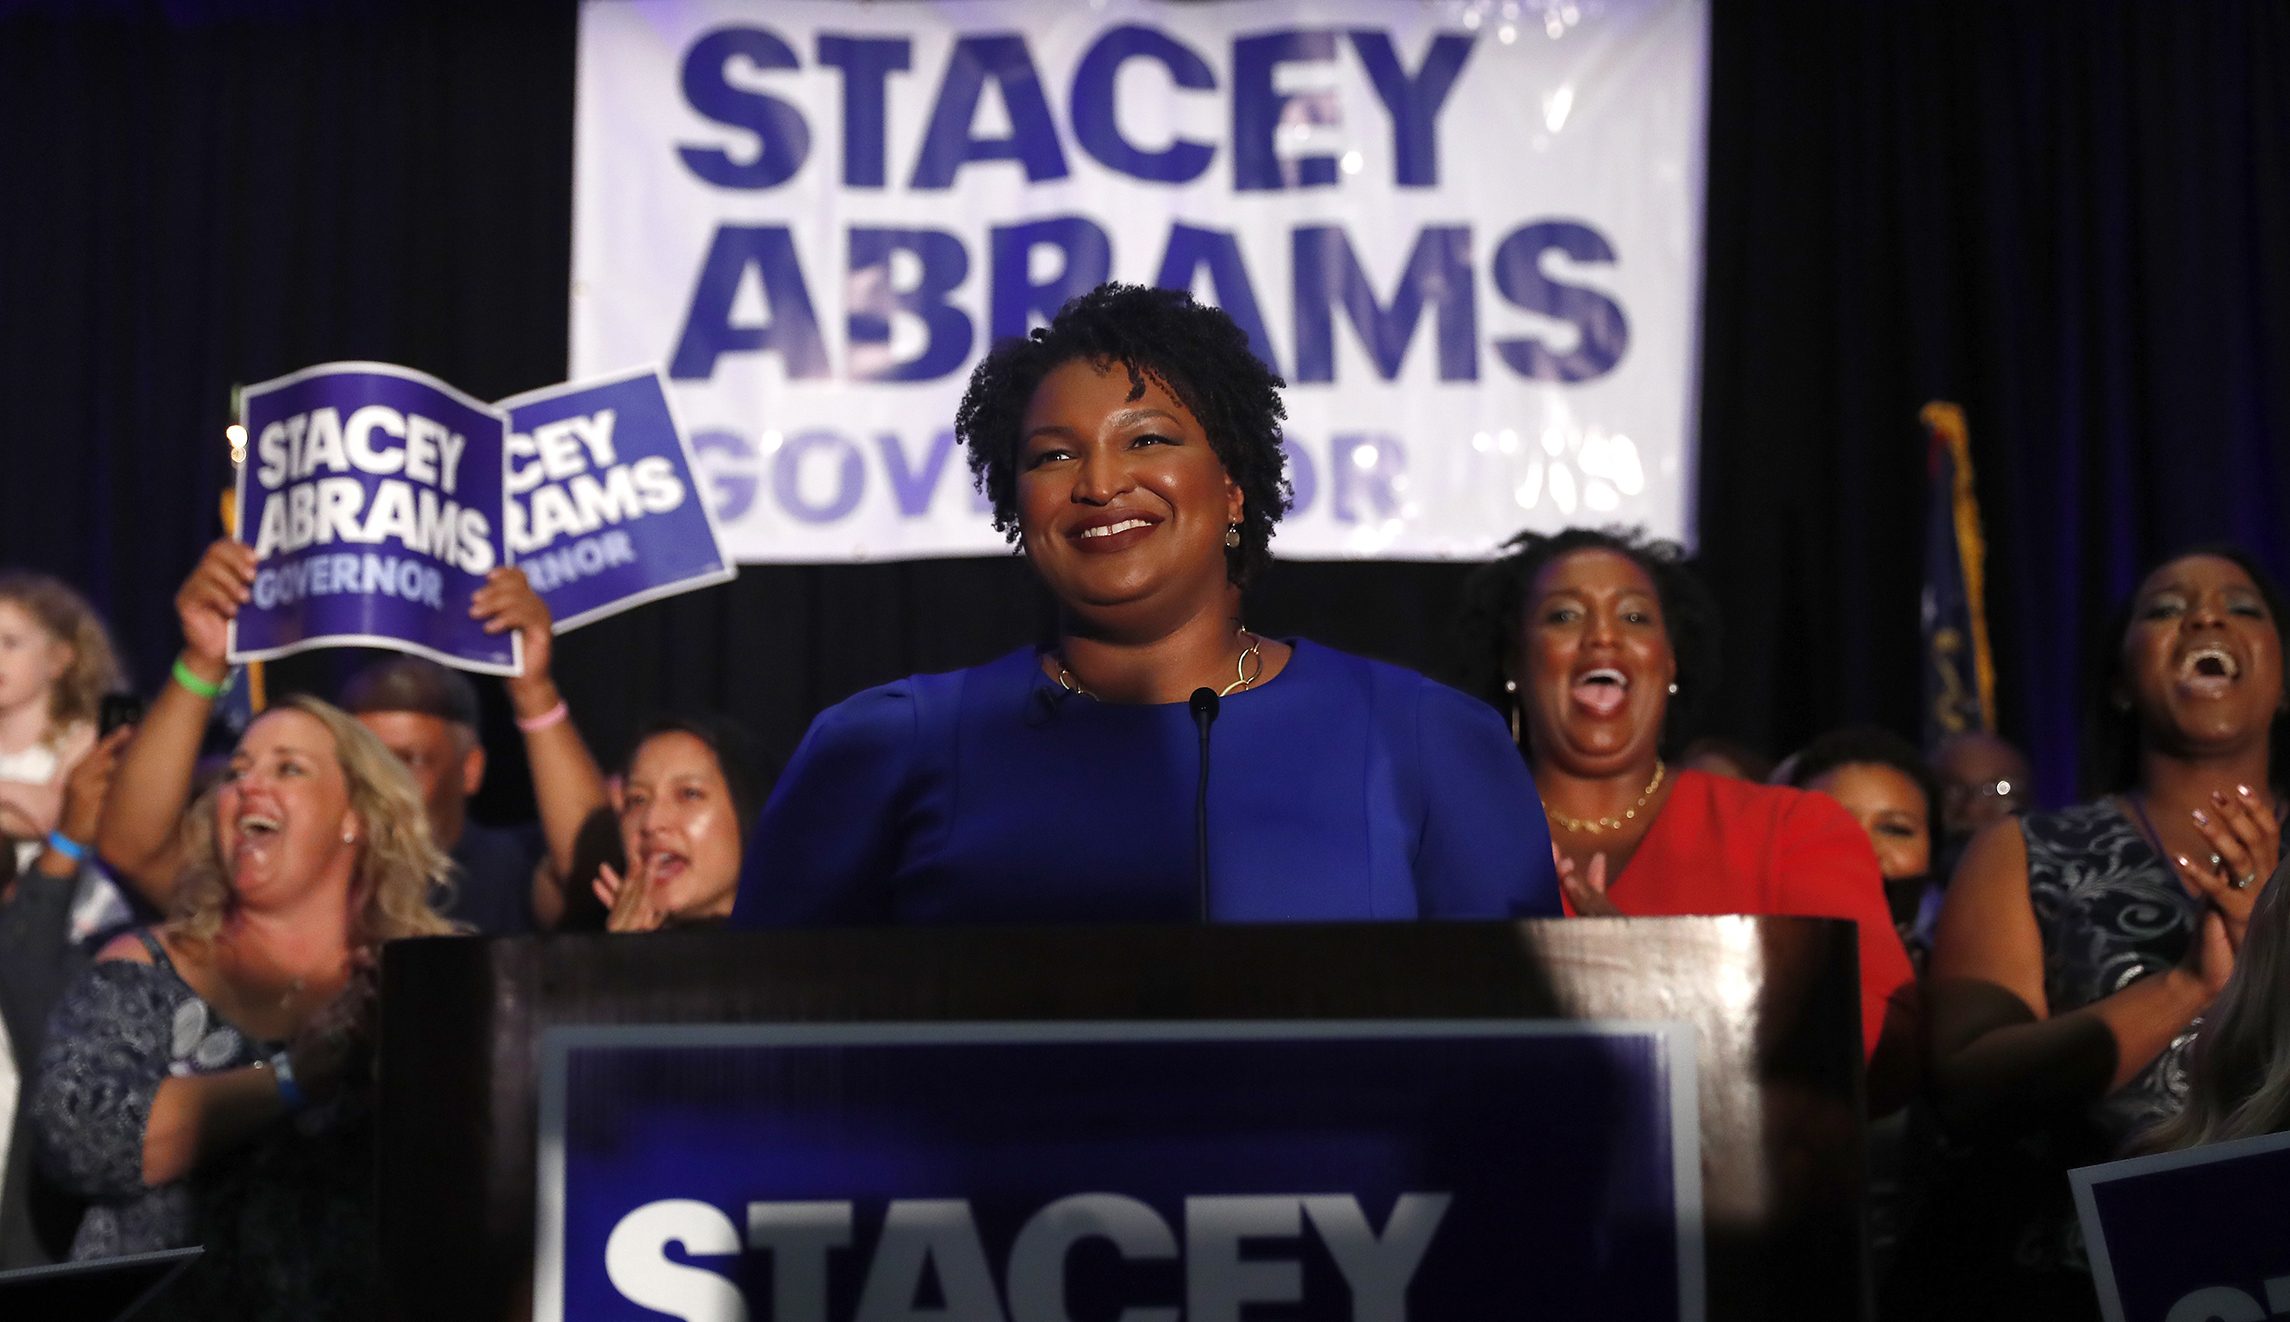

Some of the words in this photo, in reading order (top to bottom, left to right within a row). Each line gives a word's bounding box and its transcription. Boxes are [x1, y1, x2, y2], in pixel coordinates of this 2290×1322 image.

[676, 25, 1478, 192] STACEY
[669, 212, 1630, 385] ABRAMS
[257, 404, 466, 494] STACEY
[505, 409, 616, 493] CEY
[256, 476, 495, 576] ABRAMS
[252, 553, 444, 610] GOVERNOR
[604, 1193, 1453, 1322] STACEY
